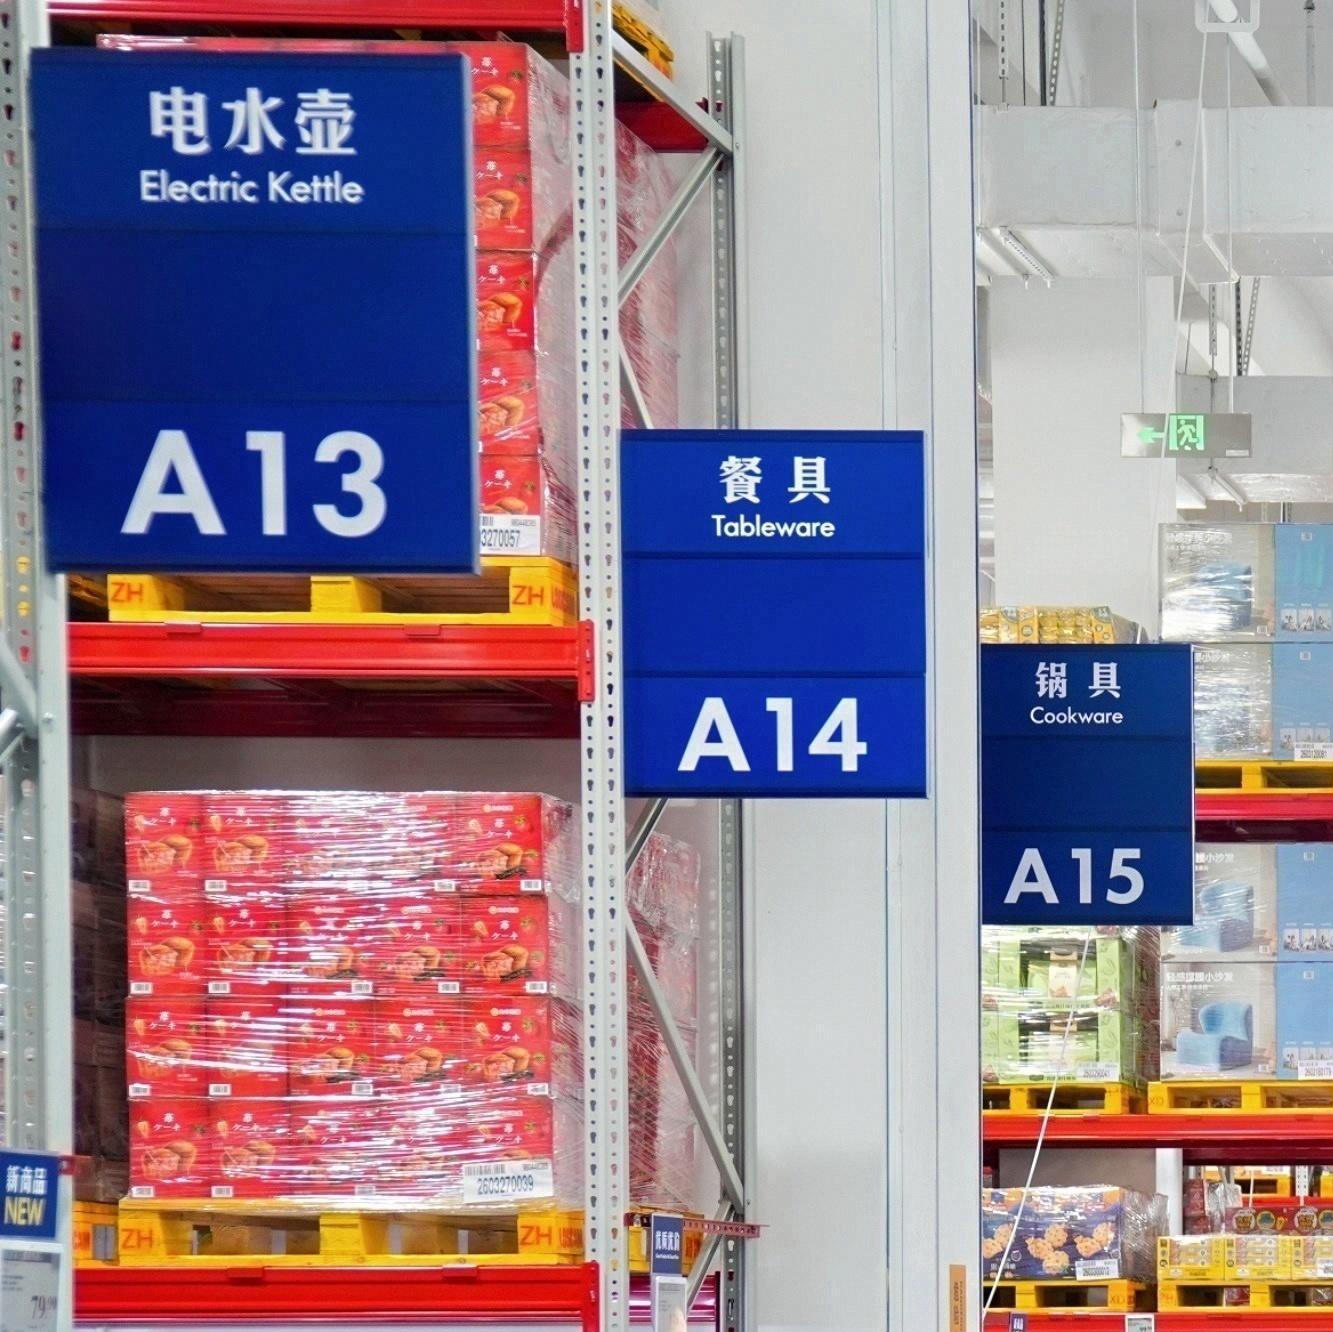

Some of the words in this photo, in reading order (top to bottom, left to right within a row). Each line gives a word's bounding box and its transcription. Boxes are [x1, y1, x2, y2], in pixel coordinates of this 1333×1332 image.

[149, 86, 357, 155] 电水壶
[140, 169, 258, 203] Electric
[267, 170, 364, 203] Kettle
[120, 429, 387, 538] A13
[719, 455, 831, 504] 餐具
[711, 513, 836, 538] Tableware
[110, 583, 143, 603] ZH
[511, 586, 544, 606] ZH
[1035, 661, 1121, 699] 锅具
[1030, 706, 1124, 725] Cookware
[677, 697, 868, 772] A14
[1003, 847, 1145, 905] A15
[477, 1173, 534, 1196] 2603270039
[4, 1196, 46, 1226] NEW
[120, 1228, 154, 1250] ZH
[520, 1225, 553, 1246] ZH
